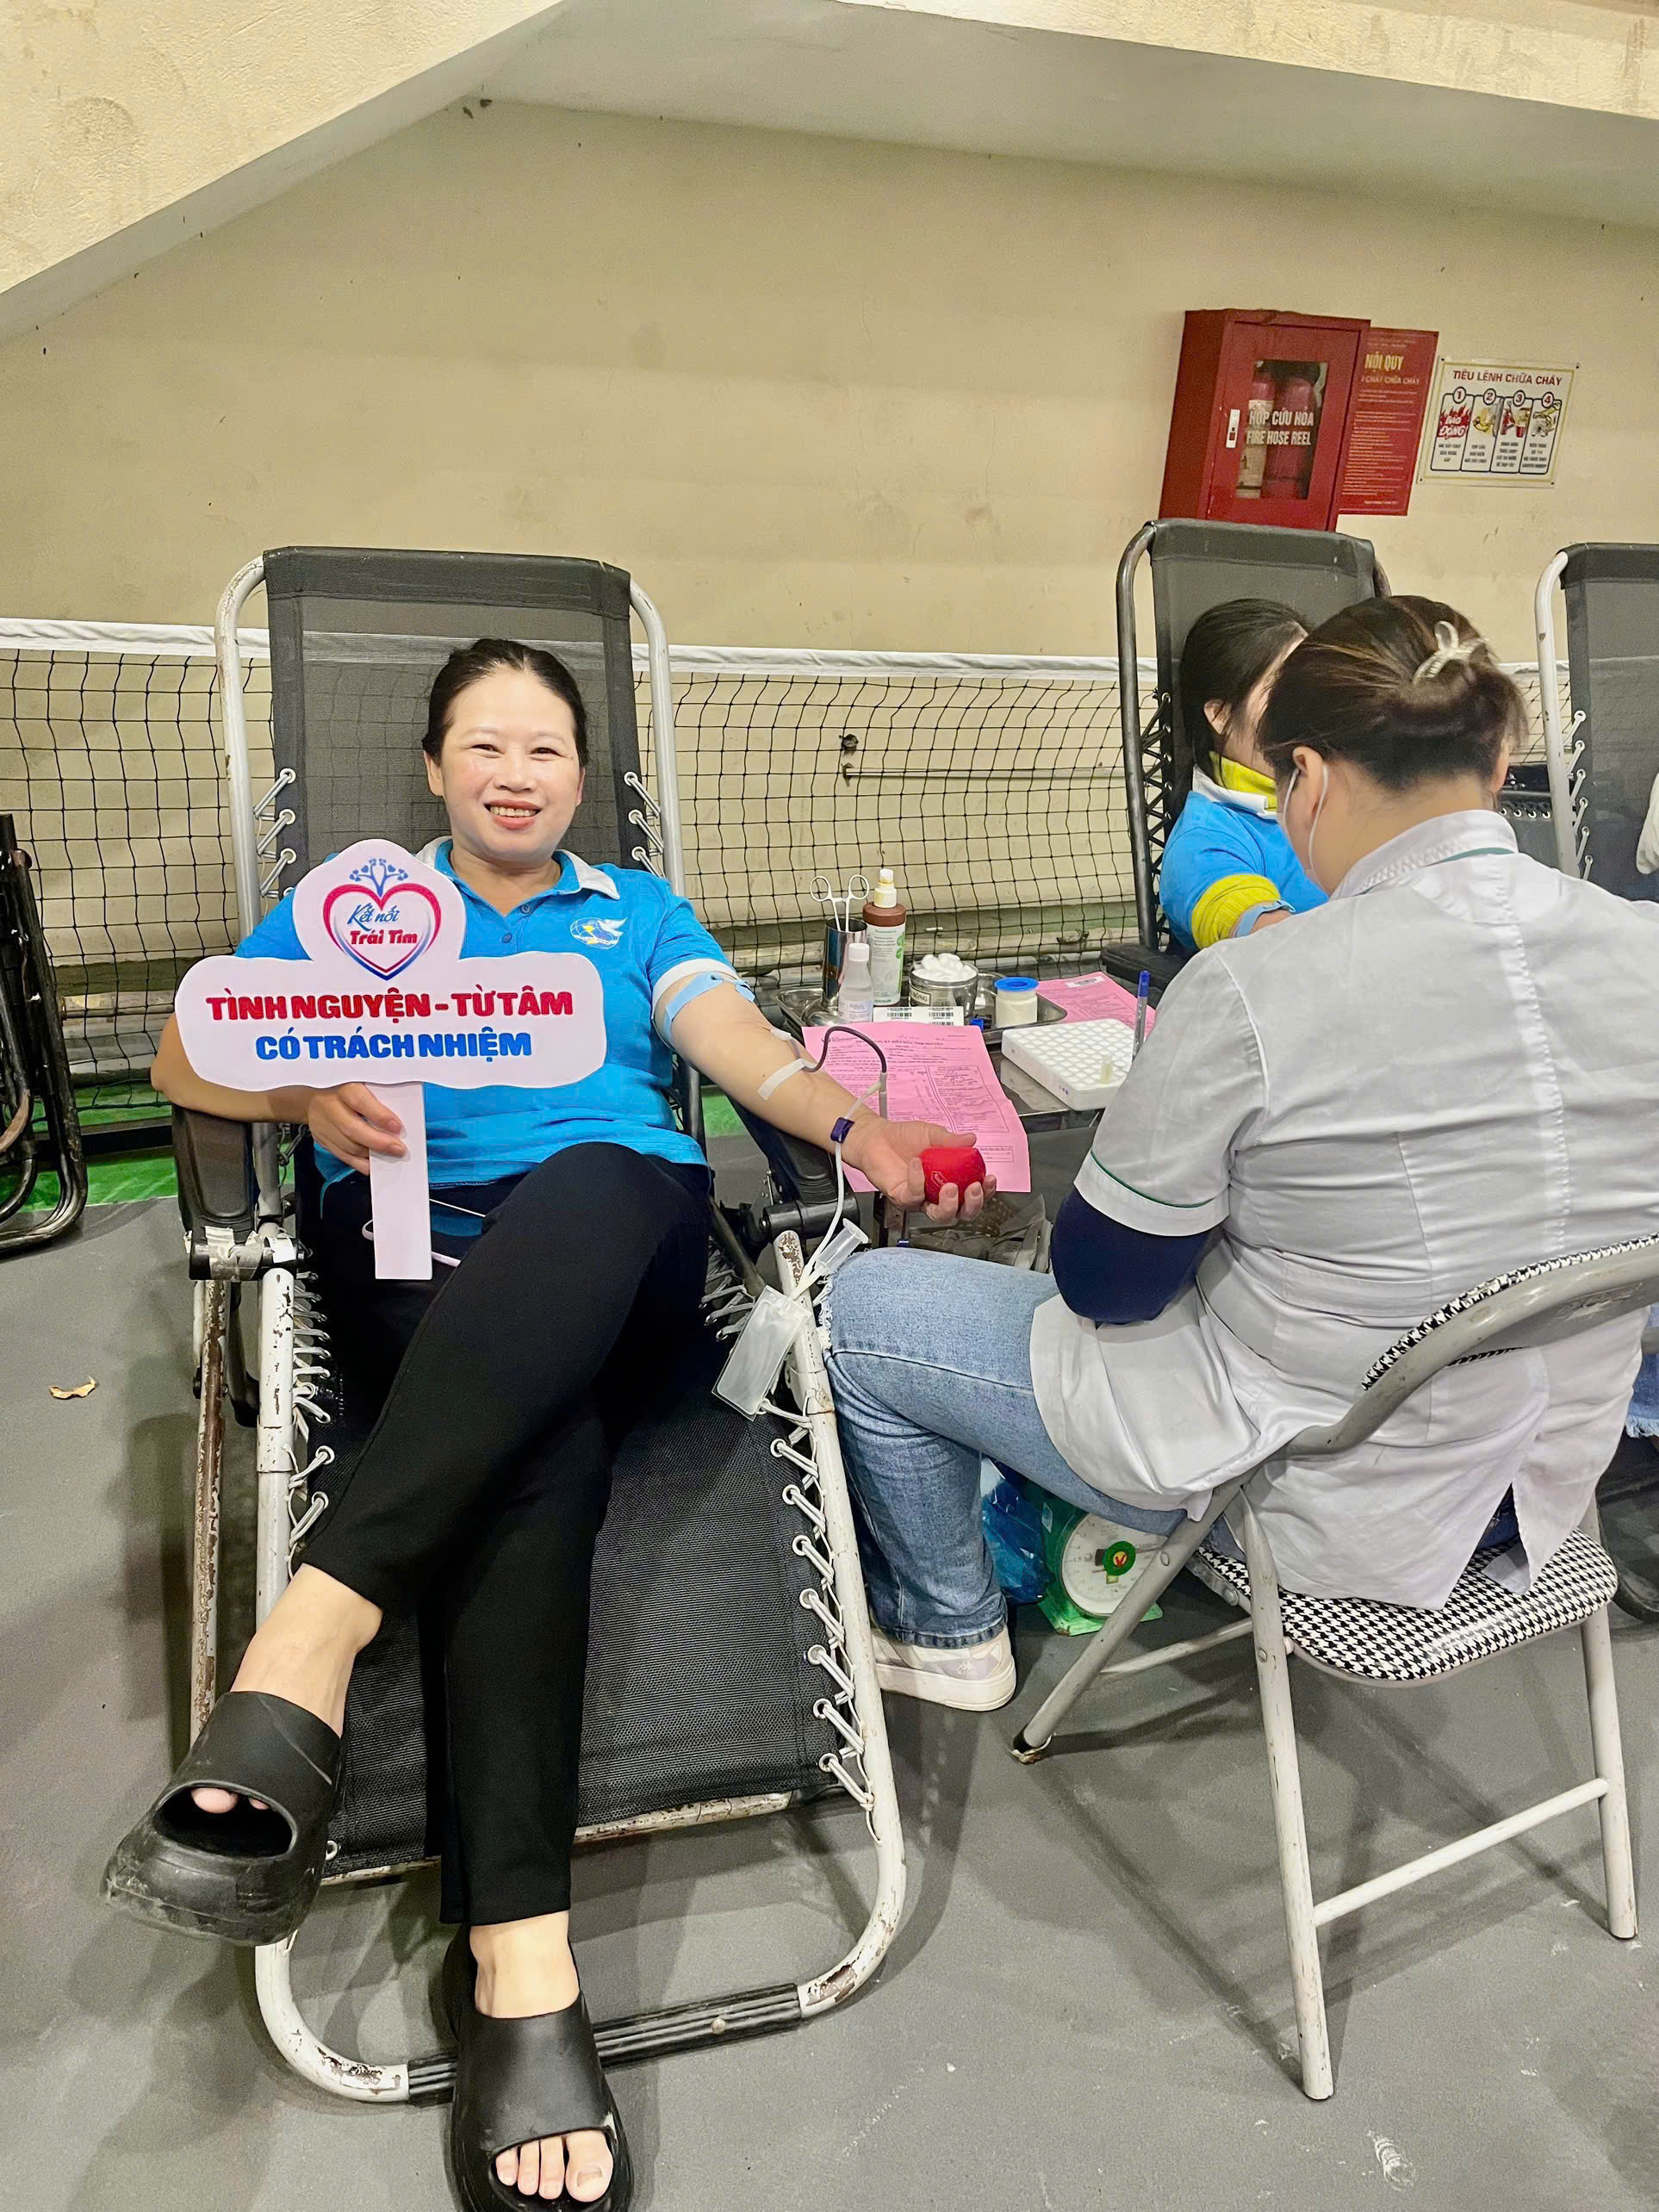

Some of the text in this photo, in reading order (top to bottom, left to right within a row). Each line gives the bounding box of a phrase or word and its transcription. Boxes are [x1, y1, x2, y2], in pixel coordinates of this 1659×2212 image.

[1364, 351, 1405, 372] NỘI QUY
[1453, 369, 1563, 386] TIÊU LỆNH CHỮA CHÁY
[1457, 391, 1462, 400] 1
[1516, 394, 1523, 402] 3
[1544, 395, 1551, 404] 4
[1271, 407, 1293, 426] CỨU
[1246, 431, 1311, 445] FIRE HOSE REEL
[346, 903, 401, 932] Kết nối
[351, 929, 418, 945] Trái Tim
[205, 987, 288, 1021] TÌNH
[290, 987, 432, 1024] NGUYỆN
[450, 984, 496, 1017] TỪ
[496, 985, 574, 1016] TÂM
[255, 1025, 532, 1062] CÓ TRÁCH NHIỆM
